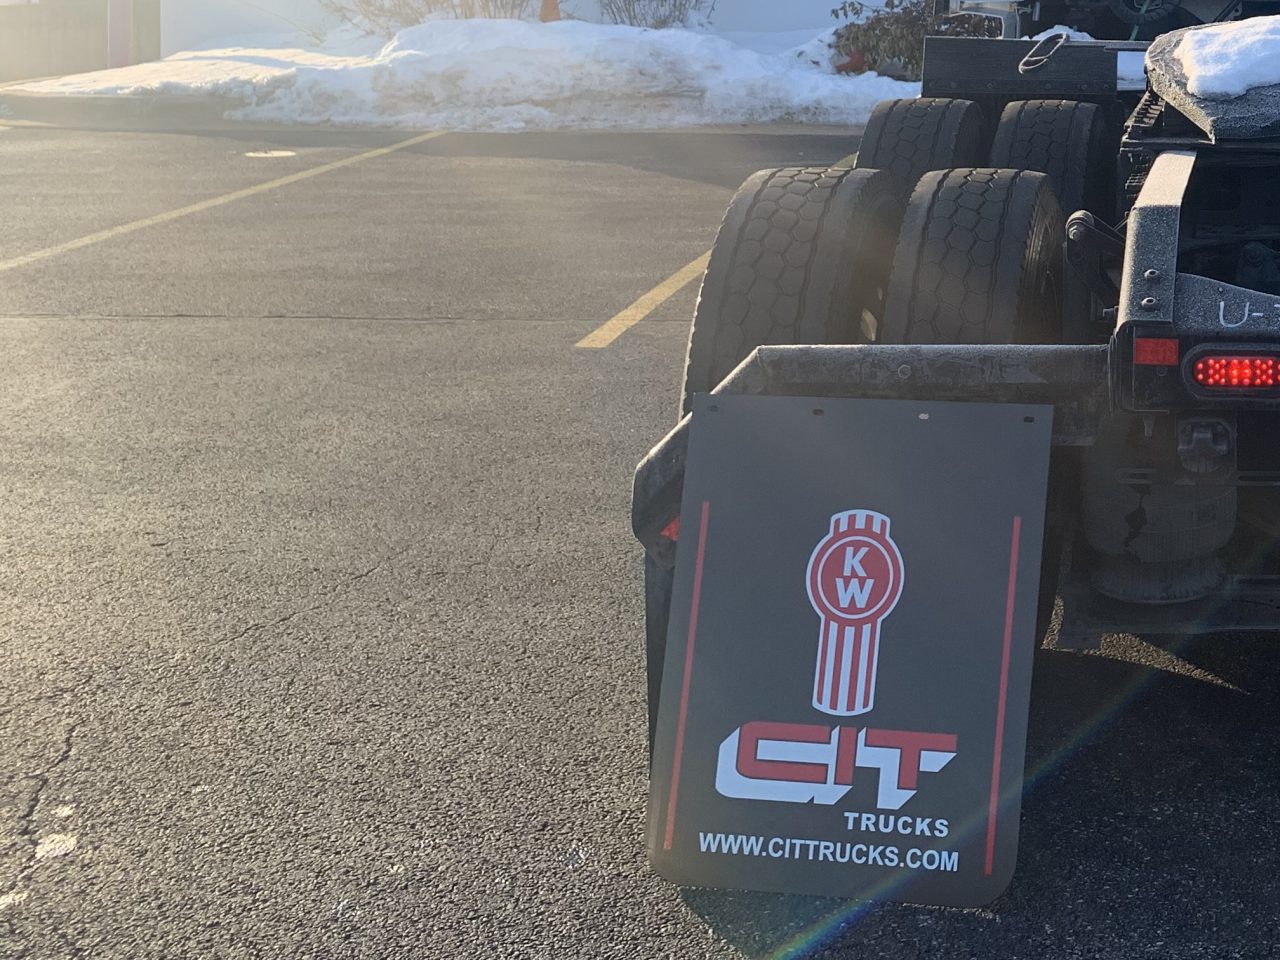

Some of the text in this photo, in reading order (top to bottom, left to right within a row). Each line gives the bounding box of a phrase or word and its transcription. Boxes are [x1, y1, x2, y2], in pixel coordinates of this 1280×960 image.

[715, 721, 958, 810] CIT
[843, 811, 950, 838] TRUCKS
[698, 832, 959, 872] WWW.CITTRUCKS.COM
